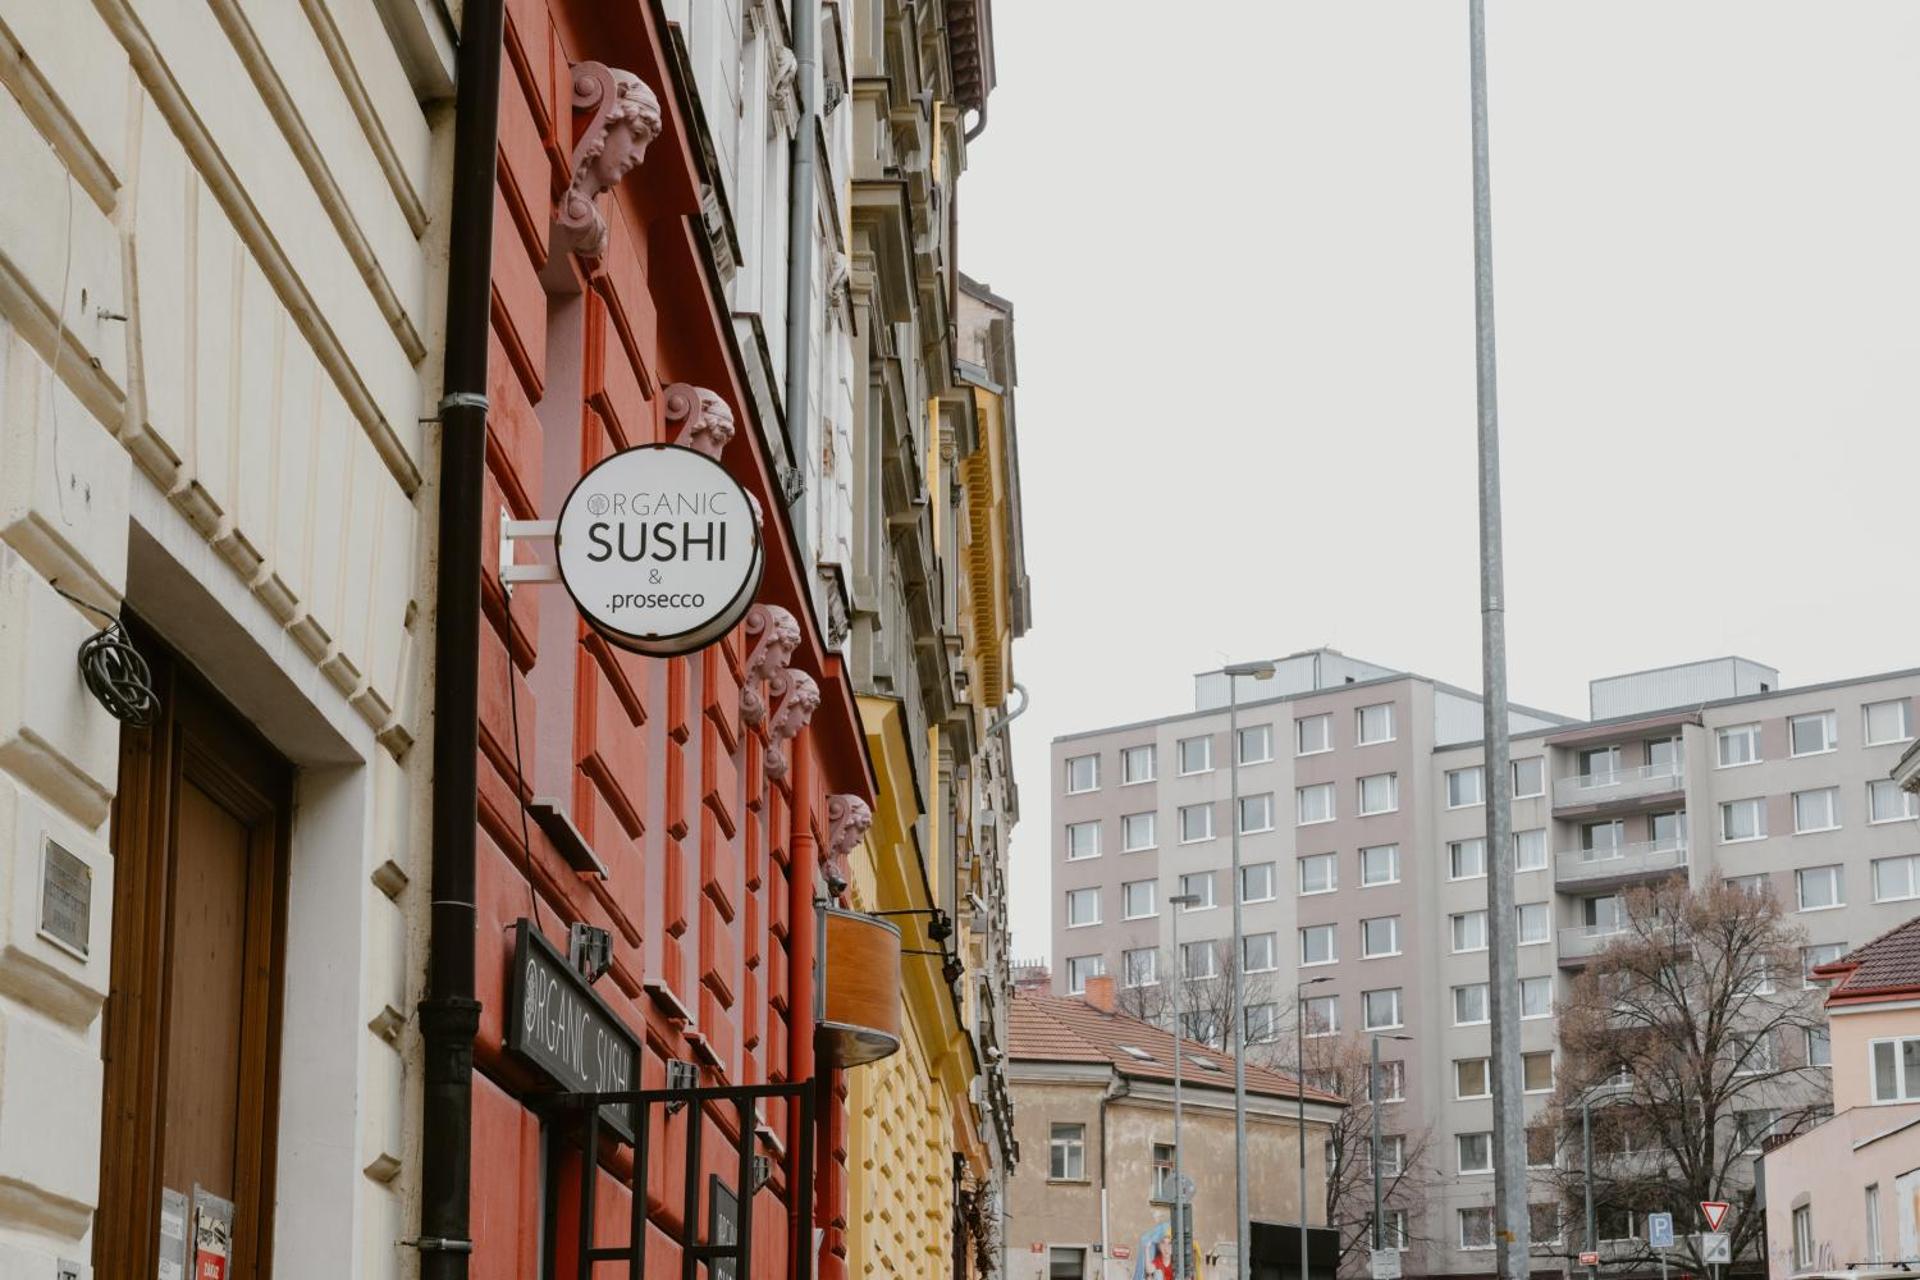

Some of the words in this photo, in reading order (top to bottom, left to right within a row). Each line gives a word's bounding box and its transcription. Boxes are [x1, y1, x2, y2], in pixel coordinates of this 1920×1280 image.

[587, 493, 728, 516] ORGANIC
[587, 522, 726, 562] SUSHI
[648, 568, 663, 585] &
[606, 593, 704, 613] .prosecco
[524, 958, 590, 1081] ORGANIC
[596, 1028, 630, 1118] SUSHI
[1655, 1218, 1667, 1237] P
